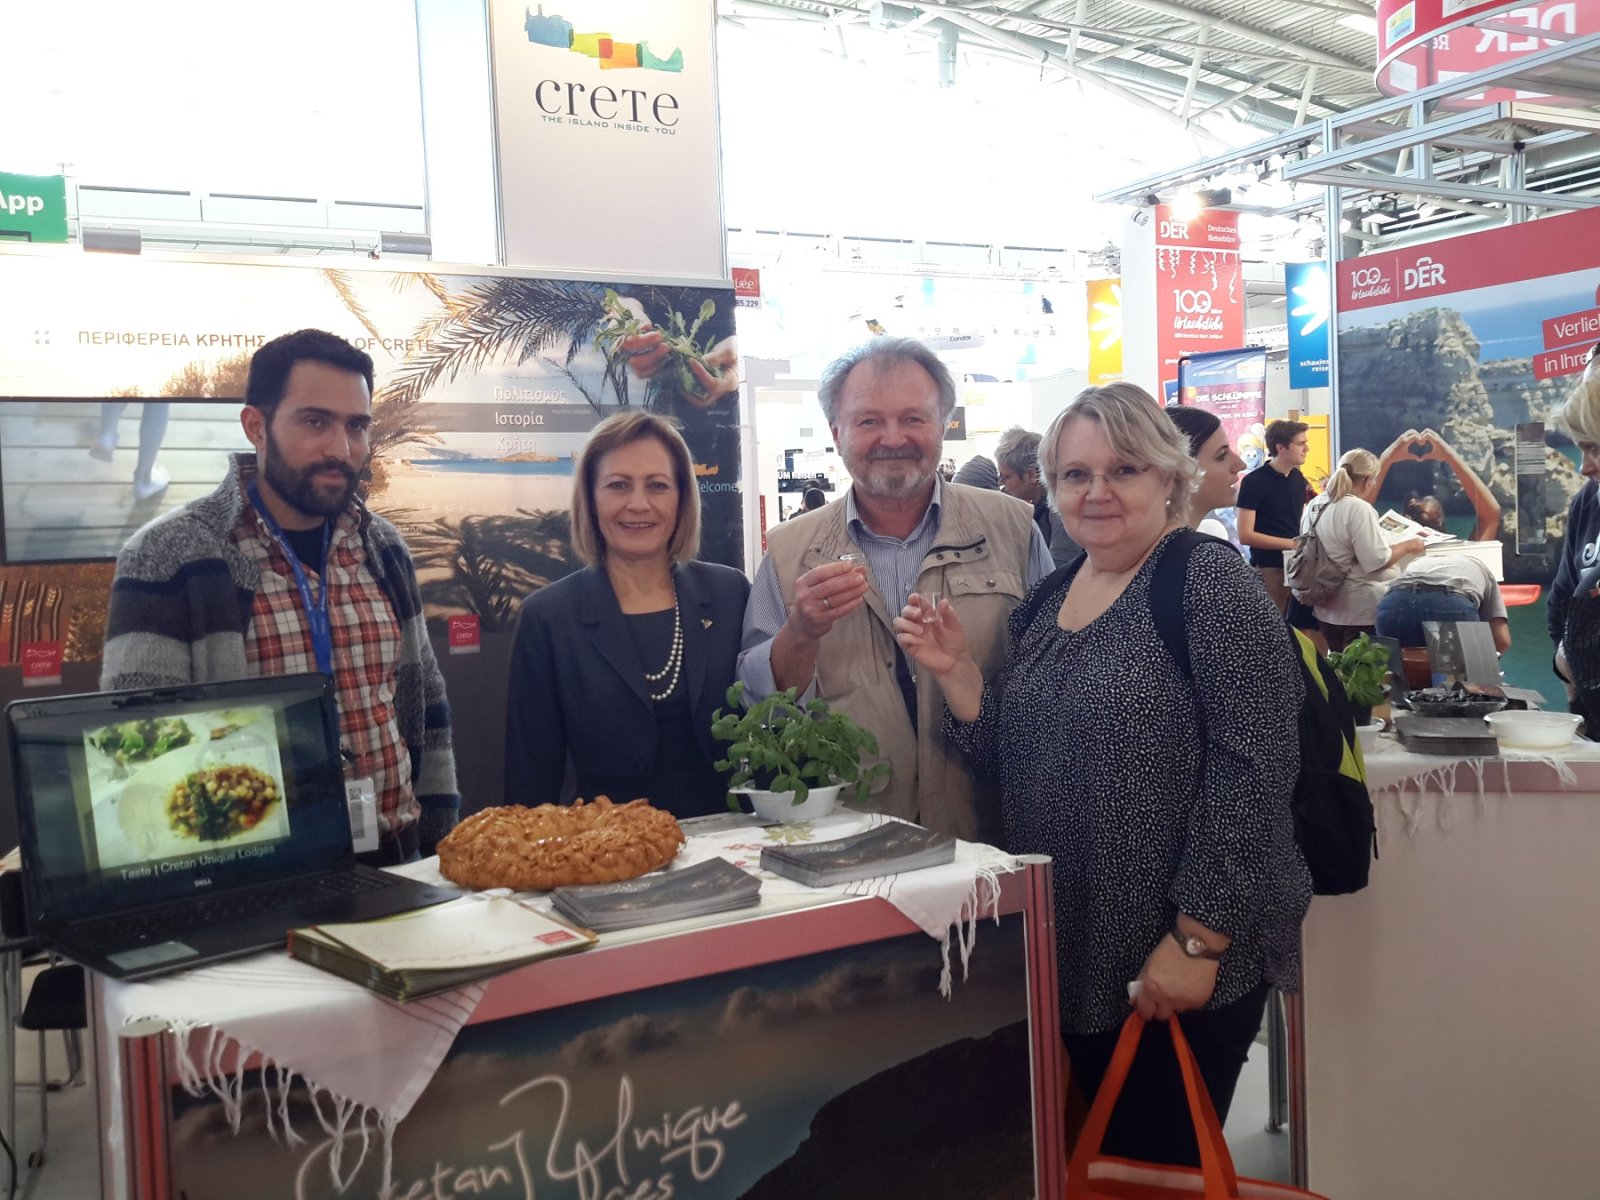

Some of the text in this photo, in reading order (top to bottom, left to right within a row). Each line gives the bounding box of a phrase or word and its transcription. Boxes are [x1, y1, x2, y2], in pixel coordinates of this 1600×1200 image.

[541, 115, 676, 135] THE ISLAND INSIDE YOU
[1160, 221, 1189, 239] DER
[1404, 263, 1446, 291] DER
[78, 331, 267, 348] ΠΕΡΙΦΕΡΕΙΑ ΚΡΗΤΗΣ
[354, 337, 377, 351] OF
[382, 338, 436, 352] CRETE
[1544, 357, 1558, 373] in
[494, 386, 568, 404] Πολιτισμός
[495, 410, 545, 428] Ιστορία
[697, 480, 738, 493] elcome
[120, 868, 151, 881] Taste
[160, 859, 196, 873] Cretan
[200, 854, 235, 866] Unique
[238, 846, 275, 858] Lodges
